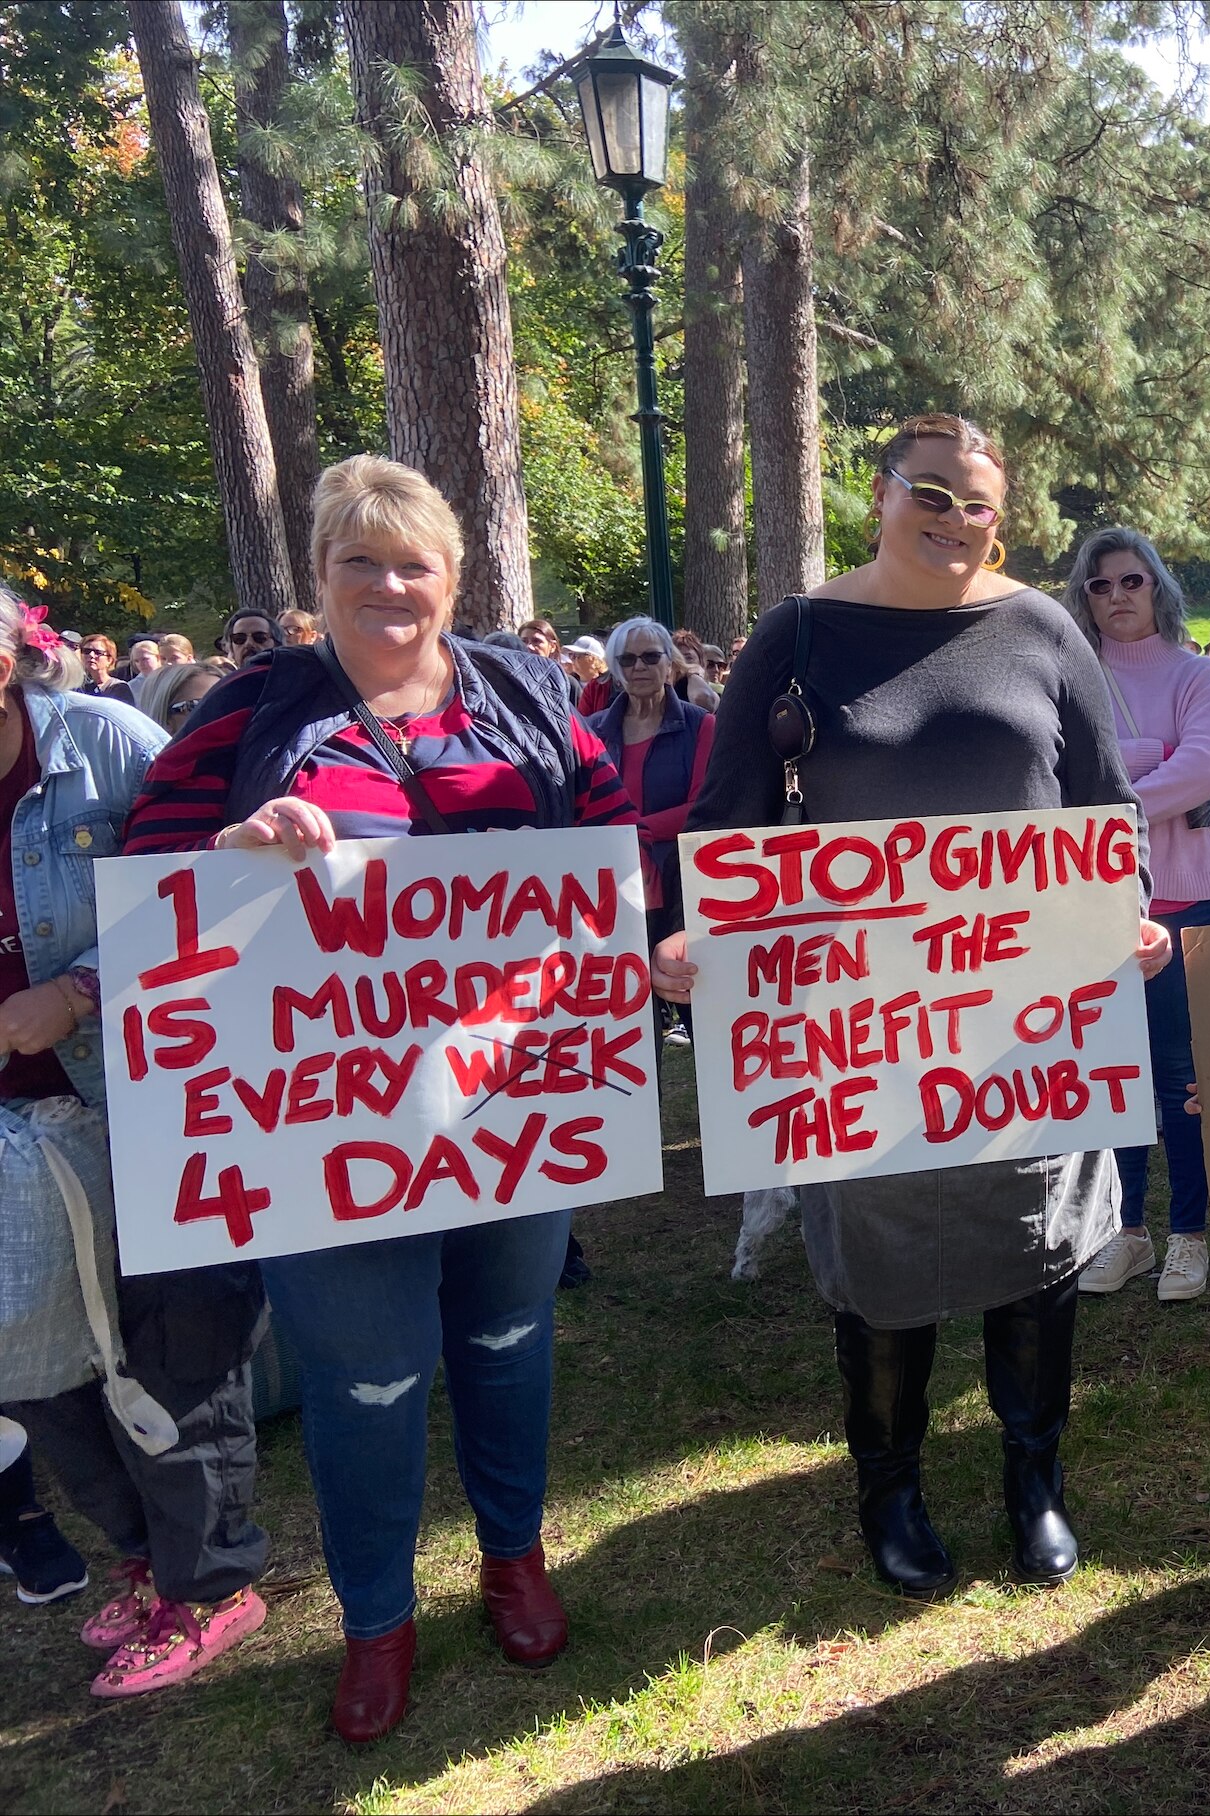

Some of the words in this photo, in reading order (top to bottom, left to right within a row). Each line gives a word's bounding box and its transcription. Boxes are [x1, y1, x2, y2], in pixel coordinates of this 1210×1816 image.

[694, 821, 927, 921] STOP
[929, 818, 1136, 892] GIVING
[138, 868, 240, 990] 1
[747, 929, 870, 1006] MEN
[913, 910, 1031, 973] THE
[123, 997, 217, 1081] IS
[273, 952, 652, 1053] MURDERED
[731, 989, 994, 1092] BENEFIT
[1013, 980, 1118, 1049] OF
[183, 1043, 423, 1138] EVERY
[444, 1026, 648, 1099] WEEK
[748, 1076, 879, 1165] THE
[918, 1059, 1141, 1144] DOUBT
[174, 1151, 272, 1248] 4
[322, 1112, 609, 1222] DAYS
